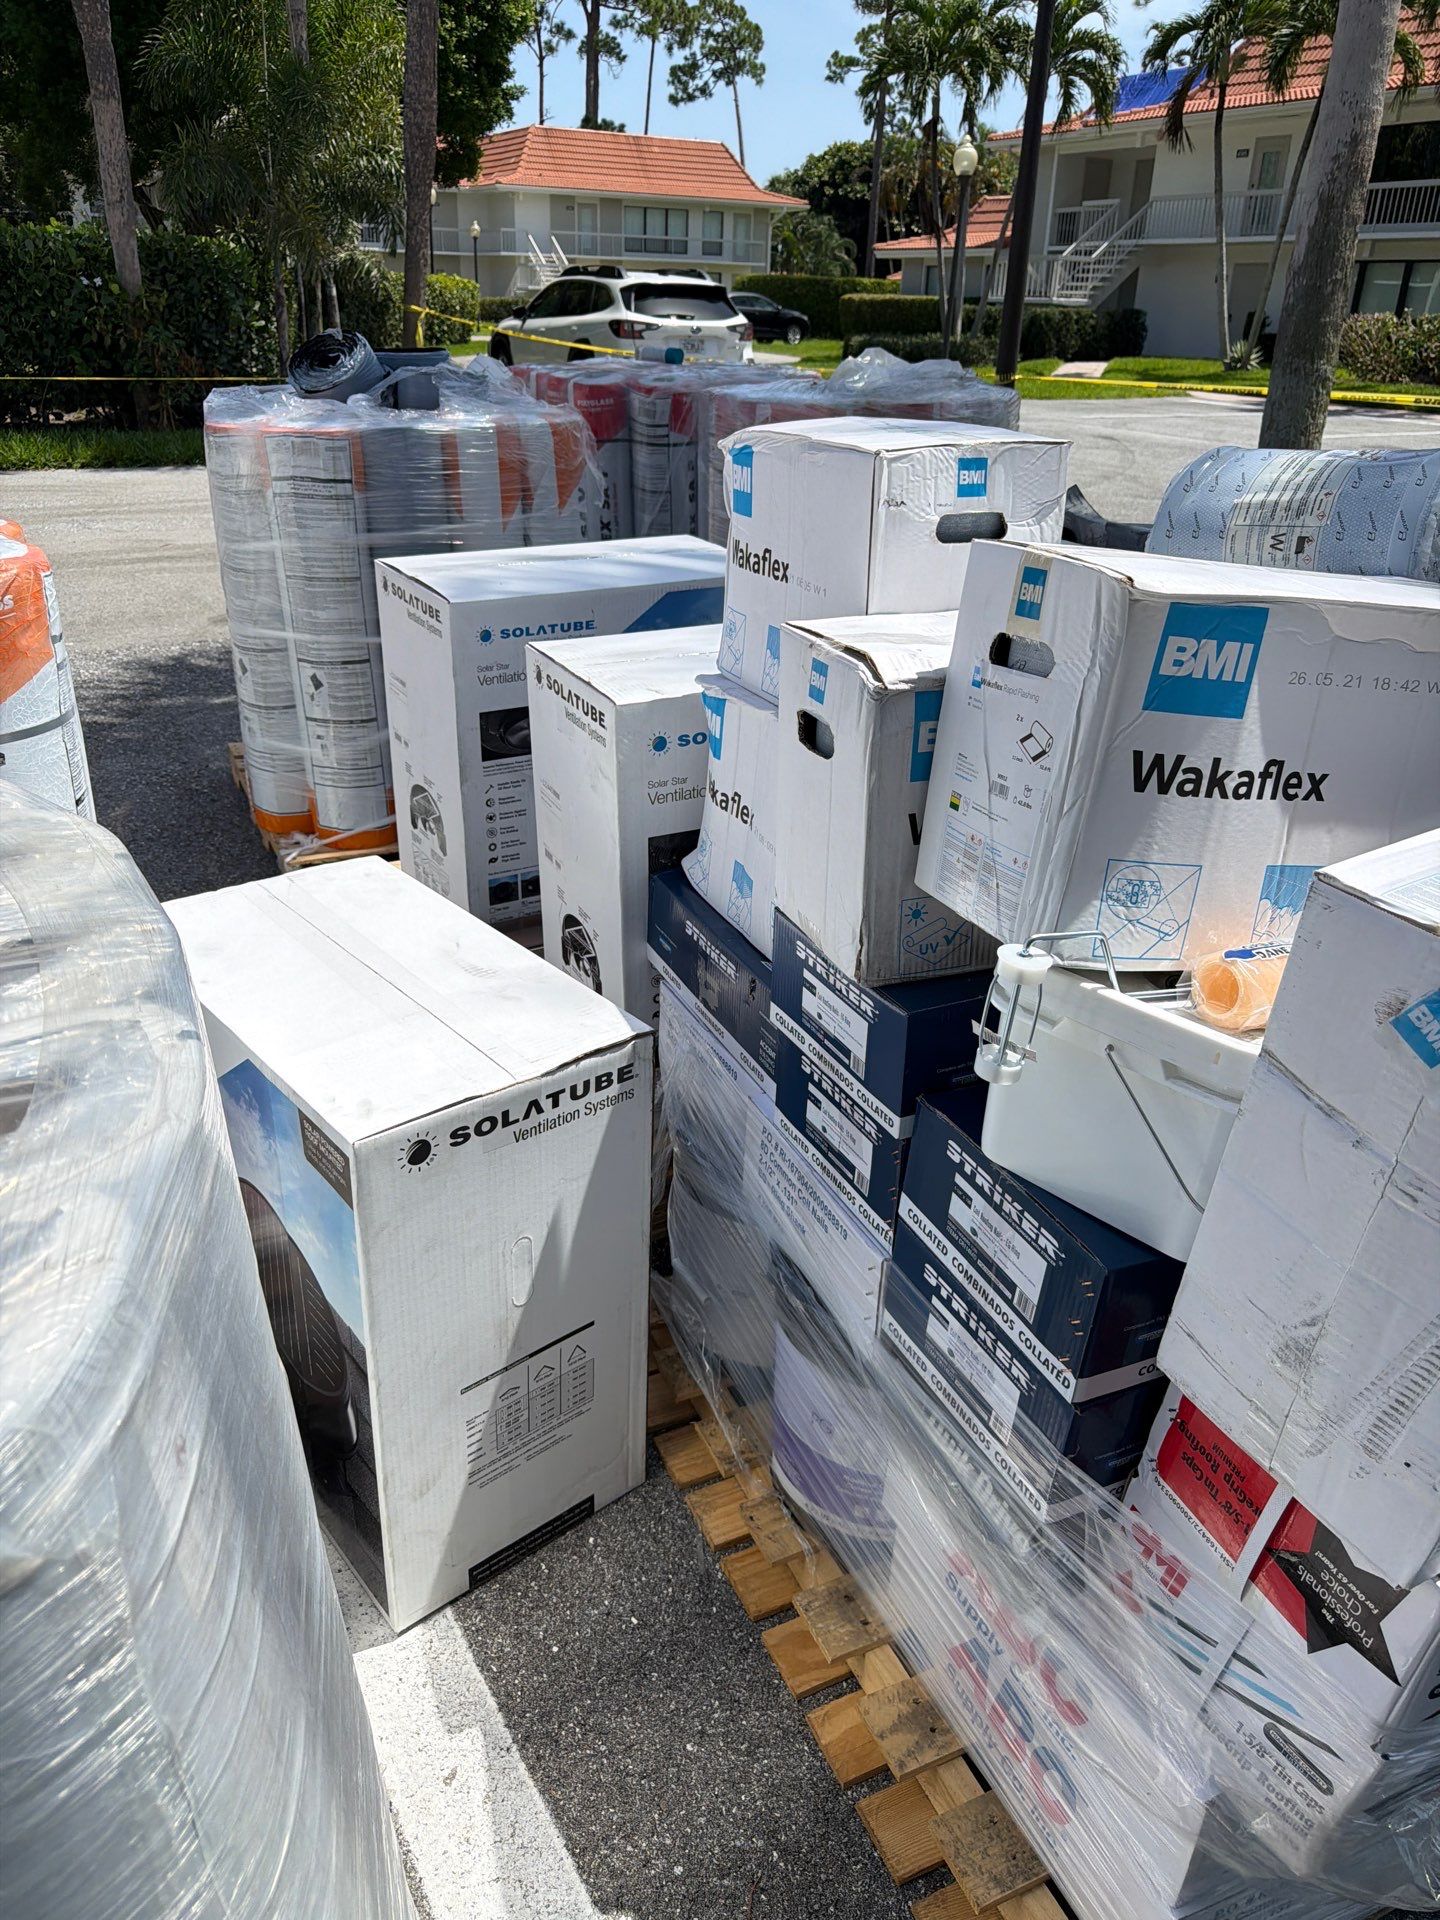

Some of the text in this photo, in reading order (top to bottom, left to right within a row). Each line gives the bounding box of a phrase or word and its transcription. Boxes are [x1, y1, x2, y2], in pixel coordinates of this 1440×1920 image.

[734, 465, 751, 493] BMI
[960, 470, 985, 484] BMI
[732, 537, 790, 584] Wakaflex
[391, 581, 442, 624] SOLATUBE
[1020, 583, 1043, 604] BMI
[500, 619, 595, 640] SOLATUBE
[476, 662, 510, 673] Solar Star
[811, 671, 826, 693] BMI
[1159, 635, 1254, 682] BMI
[1288, 671, 1362, 688] 26.05.21
[1373, 677, 1421, 693] 18:42
[546, 674, 606, 730] SOLATUBE
[1018, 686, 1040, 704] Flashing
[648, 775, 688, 790] Solar Star
[1132, 750, 1329, 802] Wakaflex
[685, 920, 739, 981] STRIKER
[918, 942, 940, 957] UV
[796, 940, 879, 1020] STRIKER
[662, 966, 764, 1082] COLLATED COMBINADOS COLLATED
[775, 1012, 806, 1045] COLLATED
[808, 1042, 854, 1092] COMBINADOS
[856, 1089, 894, 1128] COLLATED
[450, 1063, 635, 1147] SOLATUBE
[513, 1088, 635, 1143] Ventilation Systems
[801, 1054, 882, 1144] STRIKER
[780, 1118, 809, 1155] COLLATED
[811, 1153, 856, 1206] COMBINADOS
[769, 1152, 797, 1193] Common
[812, 1207, 829, 1234] Nails
[947, 1140, 1065, 1261] STRIKER
[907, 1208, 948, 1256] COLLATED
[951, 1257, 1015, 1330] COMBINADOS
[1018, 1329, 1071, 1391] COLLATED
[924, 1263, 1037, 1391] STRIKER
[888, 1322, 927, 1373] COLLATED
[931, 1374, 991, 1450] COMBINADOS
[995, 1451, 1042, 1512] COLLATED
[1177, 1420, 1220, 1474] Roofing
[1181, 1451, 1204, 1480] Caps
[1211, 1441, 1246, 1484] PREMIUM
[1203, 1474, 1221, 1503] Tin
[1314, 1551, 1339, 1576] Years!
[945, 1571, 1004, 1657] Supply
[1297, 1564, 1374, 1650] Professionals
[1319, 1571, 1361, 1613] Choice
[1321, 1607, 1336, 1625] The
[1350, 1586, 1367, 1604] Over
[1364, 1600, 1379, 1615] For
[950, 1638, 1077, 1826] ABC
[1256, 1770, 1315, 1831] Roofing
[1272, 1760, 1292, 1786] Tin
[1293, 1781, 1325, 1815] Caps
